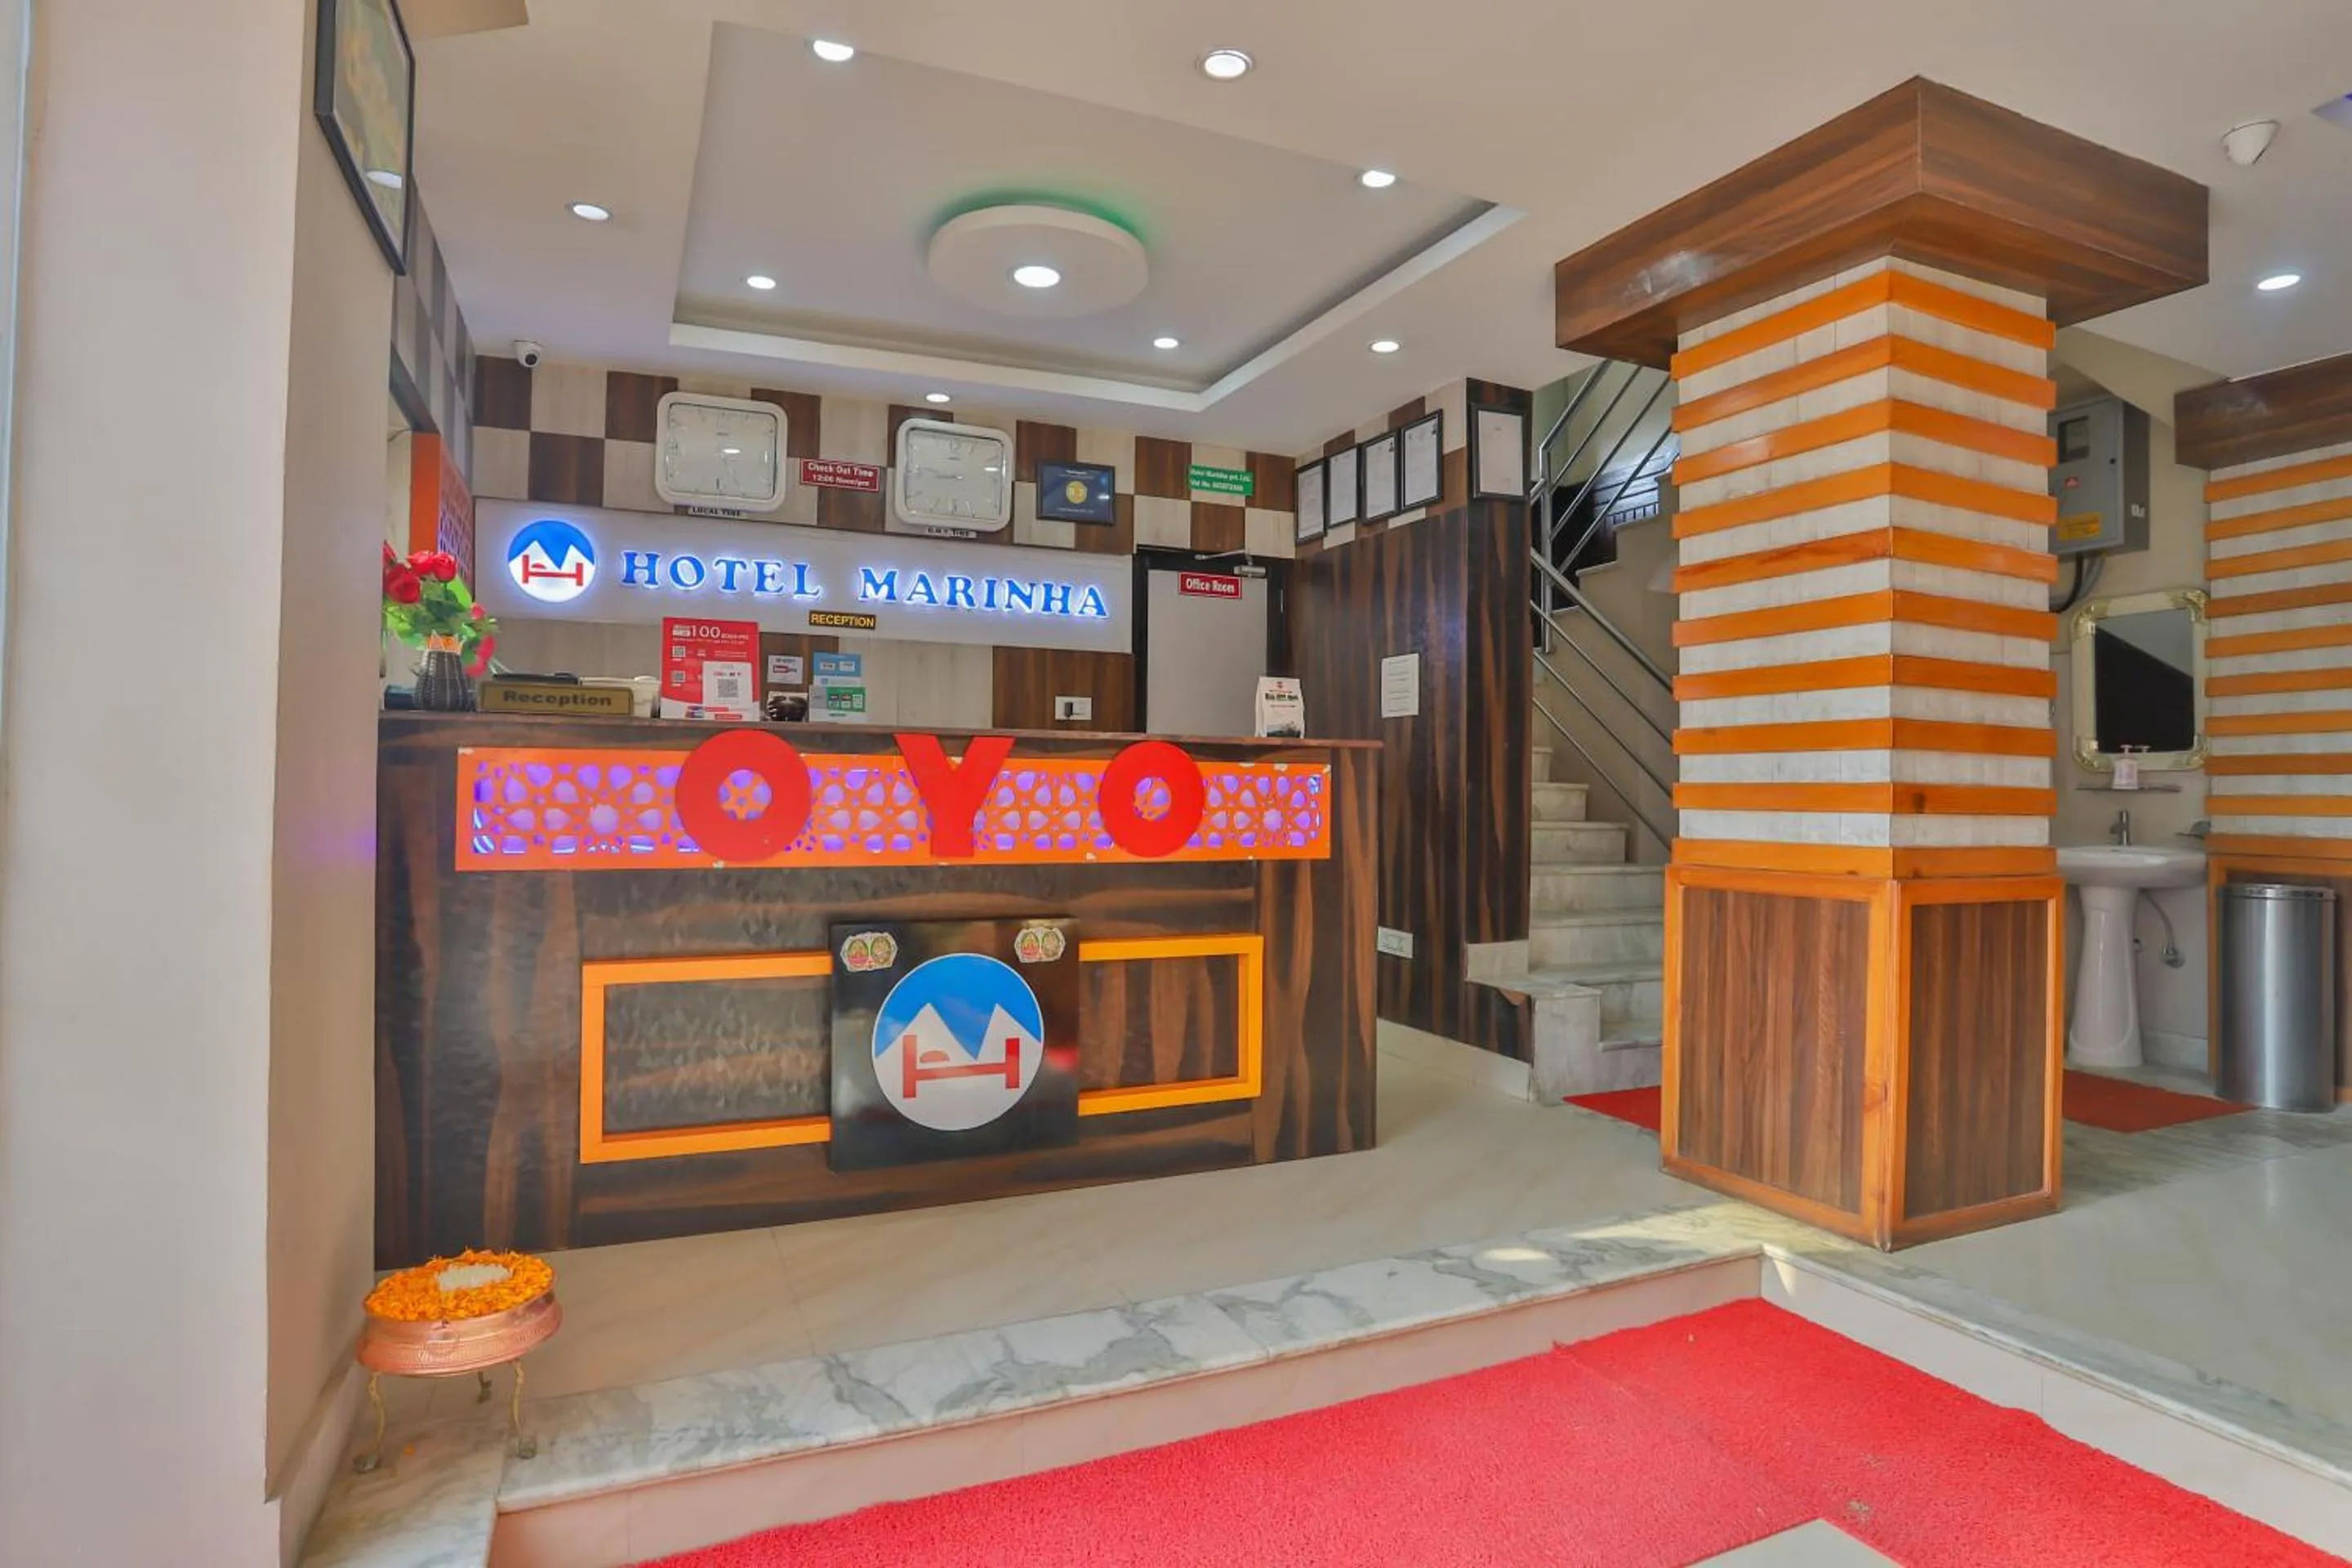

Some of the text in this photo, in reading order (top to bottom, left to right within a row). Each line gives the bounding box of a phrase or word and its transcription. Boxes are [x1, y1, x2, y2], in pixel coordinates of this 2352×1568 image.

[808, 462, 874, 477] Check Out Time
[620, 550, 1109, 618] HOTEL MARINHA
[1186, 577, 1235, 594] Office Room
[811, 613, 874, 628] RECEPTION
[503, 690, 612, 707] Reception
[675, 729, 1204, 862] OYO
